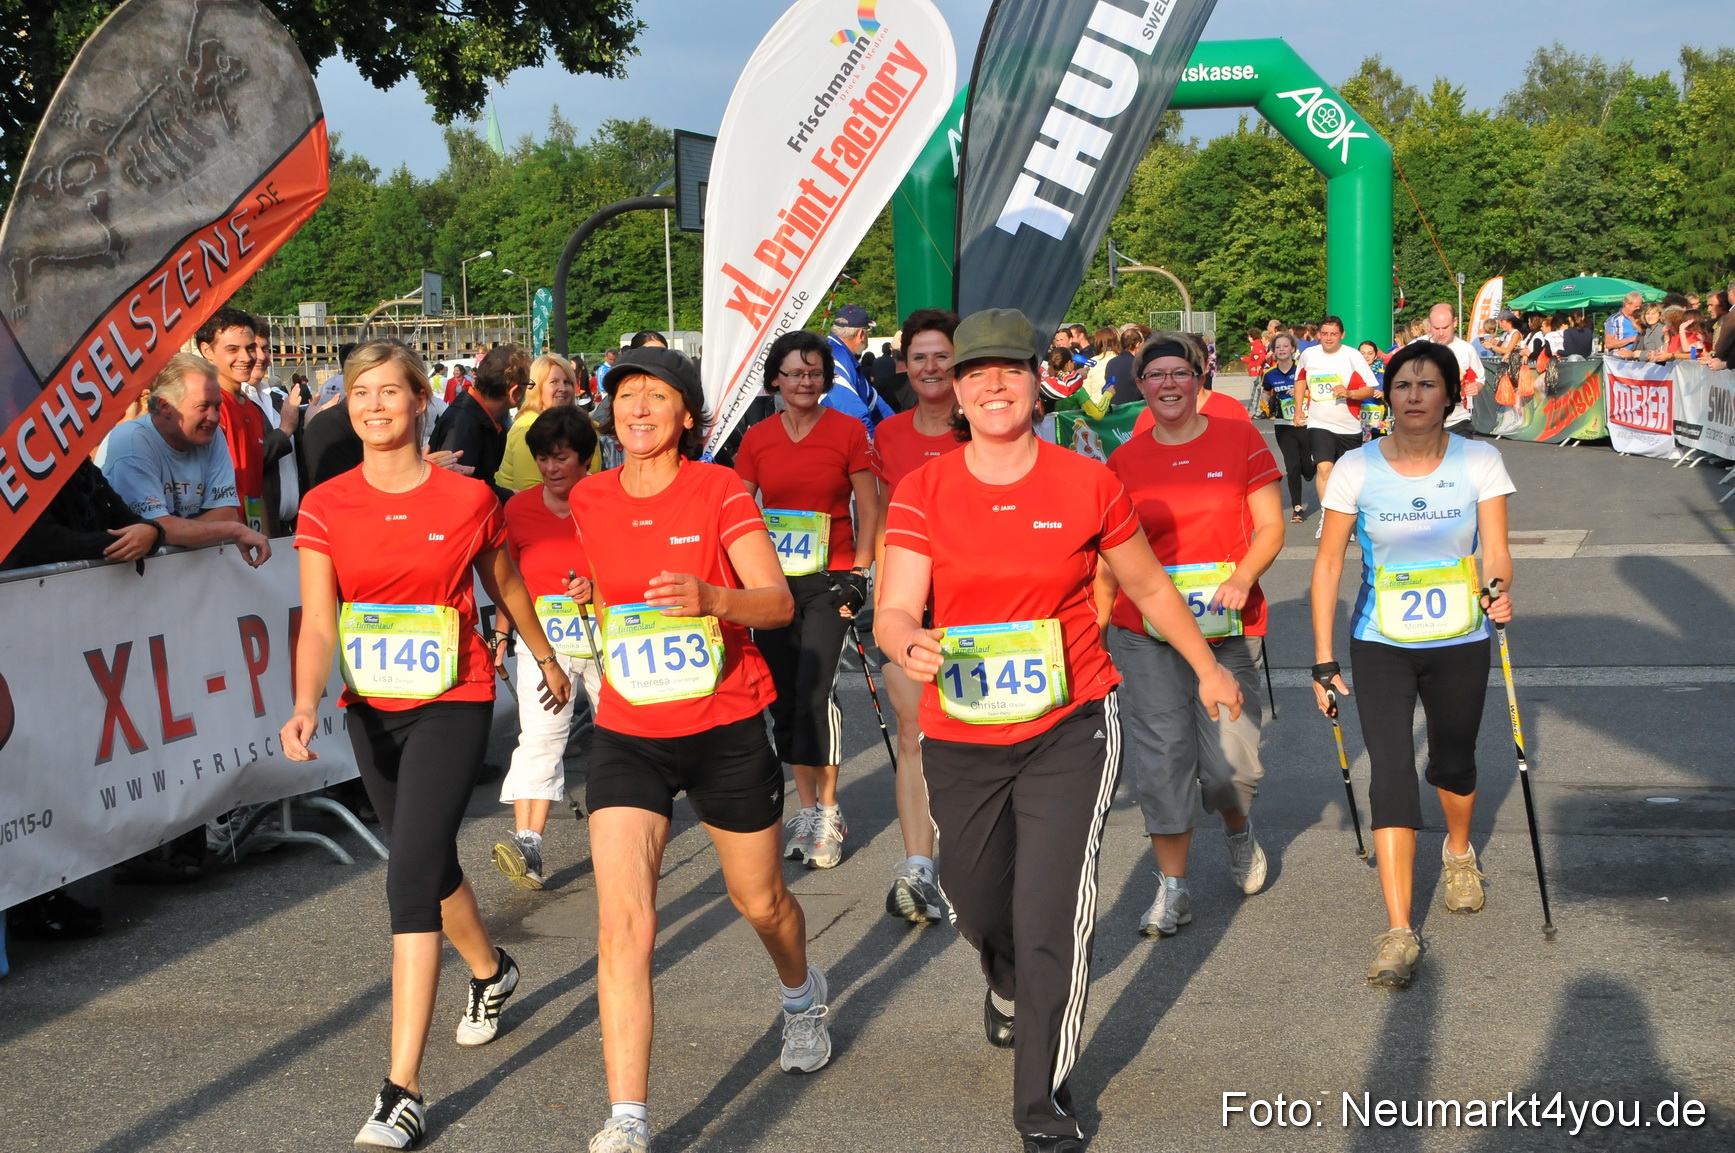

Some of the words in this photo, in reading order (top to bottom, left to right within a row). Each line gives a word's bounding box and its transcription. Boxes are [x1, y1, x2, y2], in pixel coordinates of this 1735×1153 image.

[839, 72, 861, 102] Druck
[865, 26, 889, 61] Medien
[786, 35, 870, 153] Frischmann
[1275, 86, 1370, 165] AOK
[720, 262, 782, 332] XL
[753, 177, 839, 281] Print
[810, 39, 928, 188] Factory
[1361, 411, 1380, 420] 075
[1207, 471, 1223, 479] Heidi
[1379, 508, 1462, 522] SCHABMÜLLER
[1033, 520, 1063, 529] Christa
[1409, 524, 1431, 532] TEAM
[428, 532, 445, 541] Lisa
[669, 535, 700, 546] Theresa
[1400, 588, 1447, 622] 20
[356, 622, 394, 630] firmenlauf
[546, 617, 598, 643] 647
[618, 620, 656, 633] firmenlauf
[1404, 622, 1435, 631] Monika
[347, 637, 440, 673] 1146
[611, 633, 710, 678] 1153
[951, 644, 991, 654] firmenlauf
[373, 674, 393, 682] Lisa
[631, 677, 671, 690] Theresa
[944, 658, 1047, 699] 1145
[970, 701, 1007, 711] Christa
